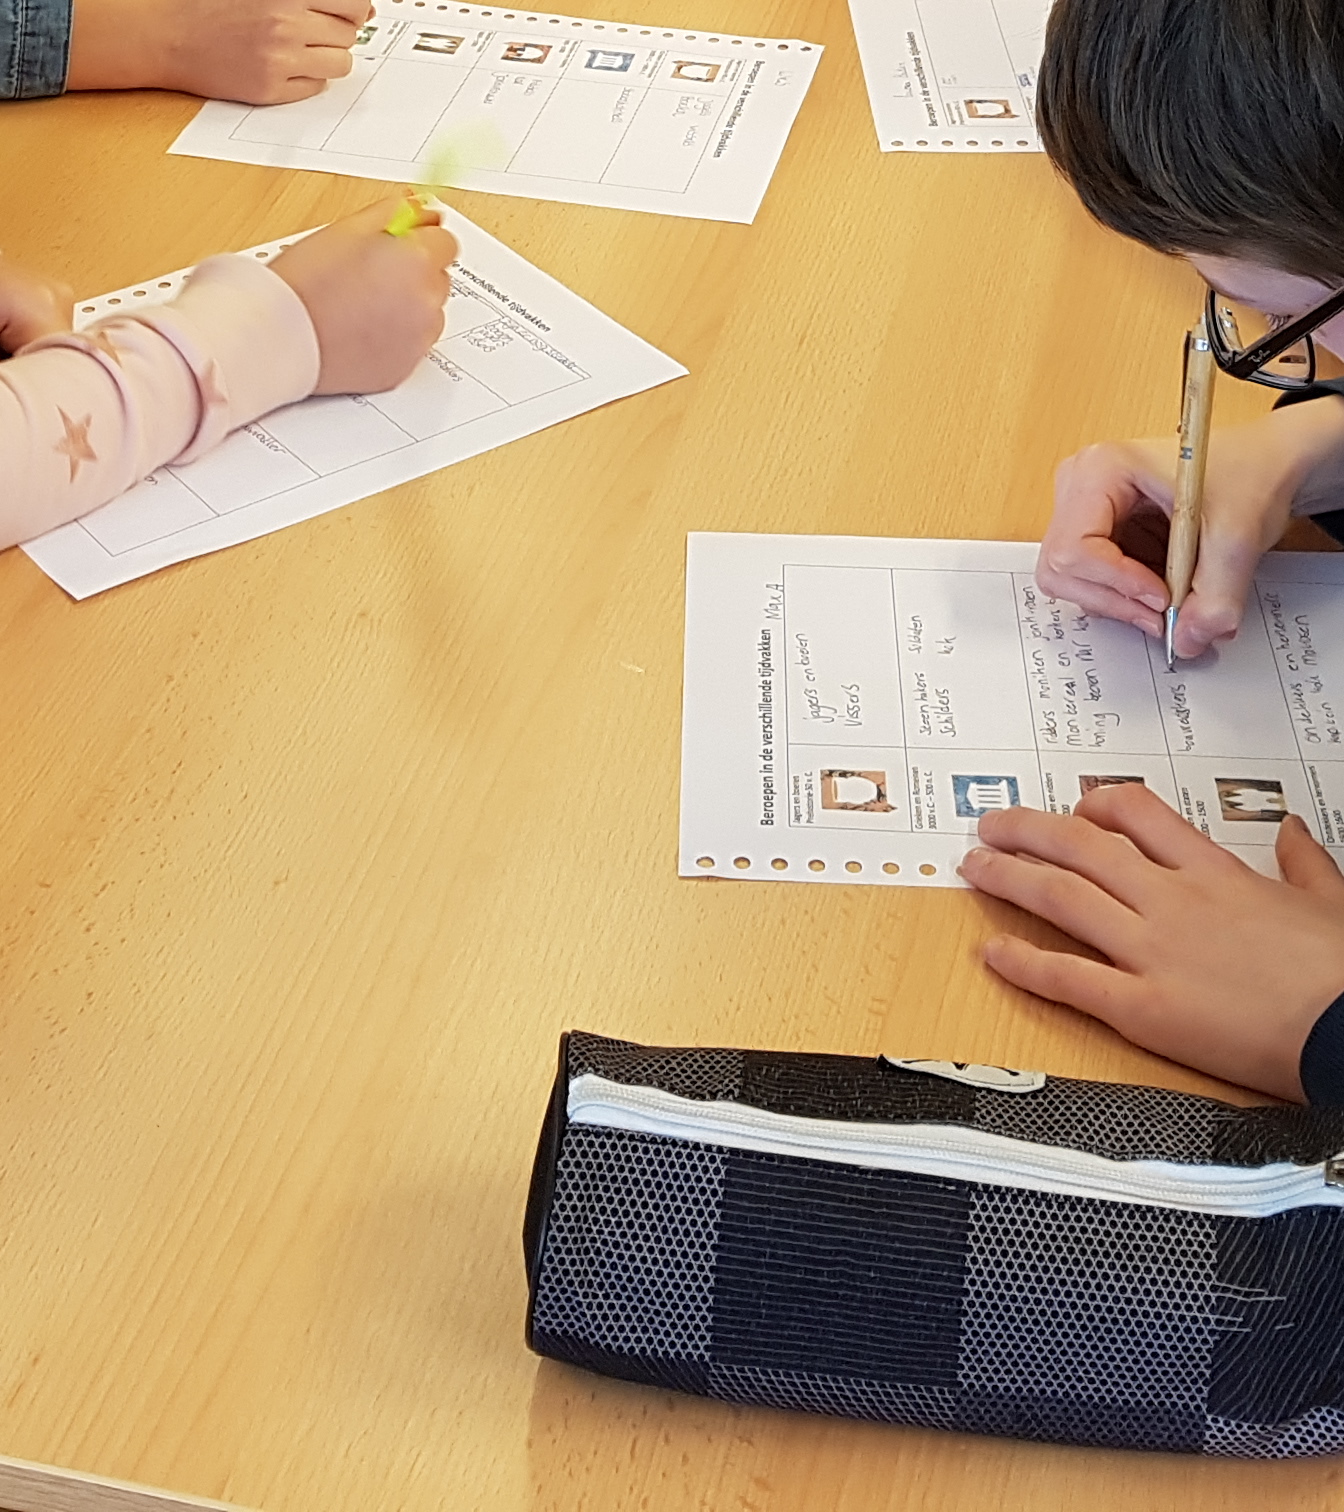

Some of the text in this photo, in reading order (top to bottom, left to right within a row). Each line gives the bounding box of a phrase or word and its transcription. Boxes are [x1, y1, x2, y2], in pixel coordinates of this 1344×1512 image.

[758, 629, 776, 826] Beroepen in de verschillende tijdvakken
